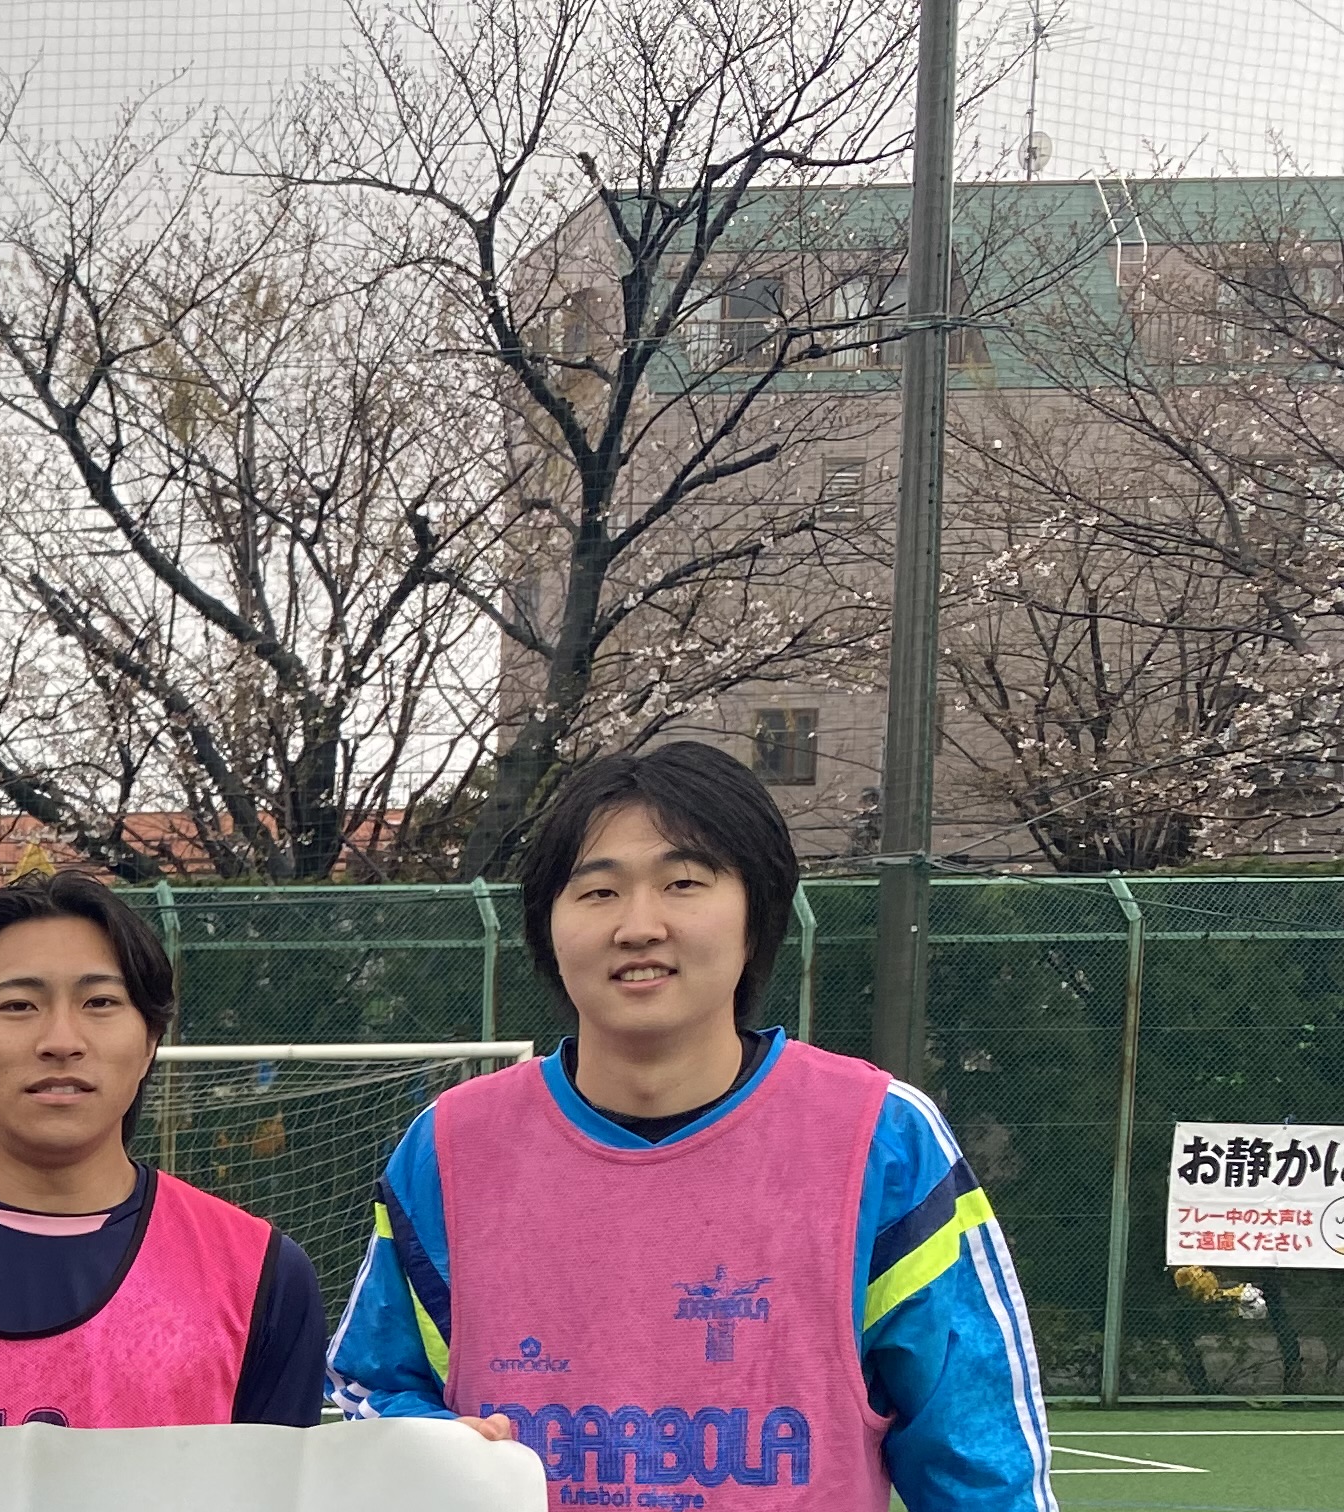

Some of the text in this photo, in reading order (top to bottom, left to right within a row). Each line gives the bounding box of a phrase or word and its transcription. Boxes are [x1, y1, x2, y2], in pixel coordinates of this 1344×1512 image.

[1178, 1208, 1313, 1226] プレー中の大声は
[1178, 1230, 1312, 1252] ご遠慮ください
[480, 1403, 811, 1487] OGARBOLA
